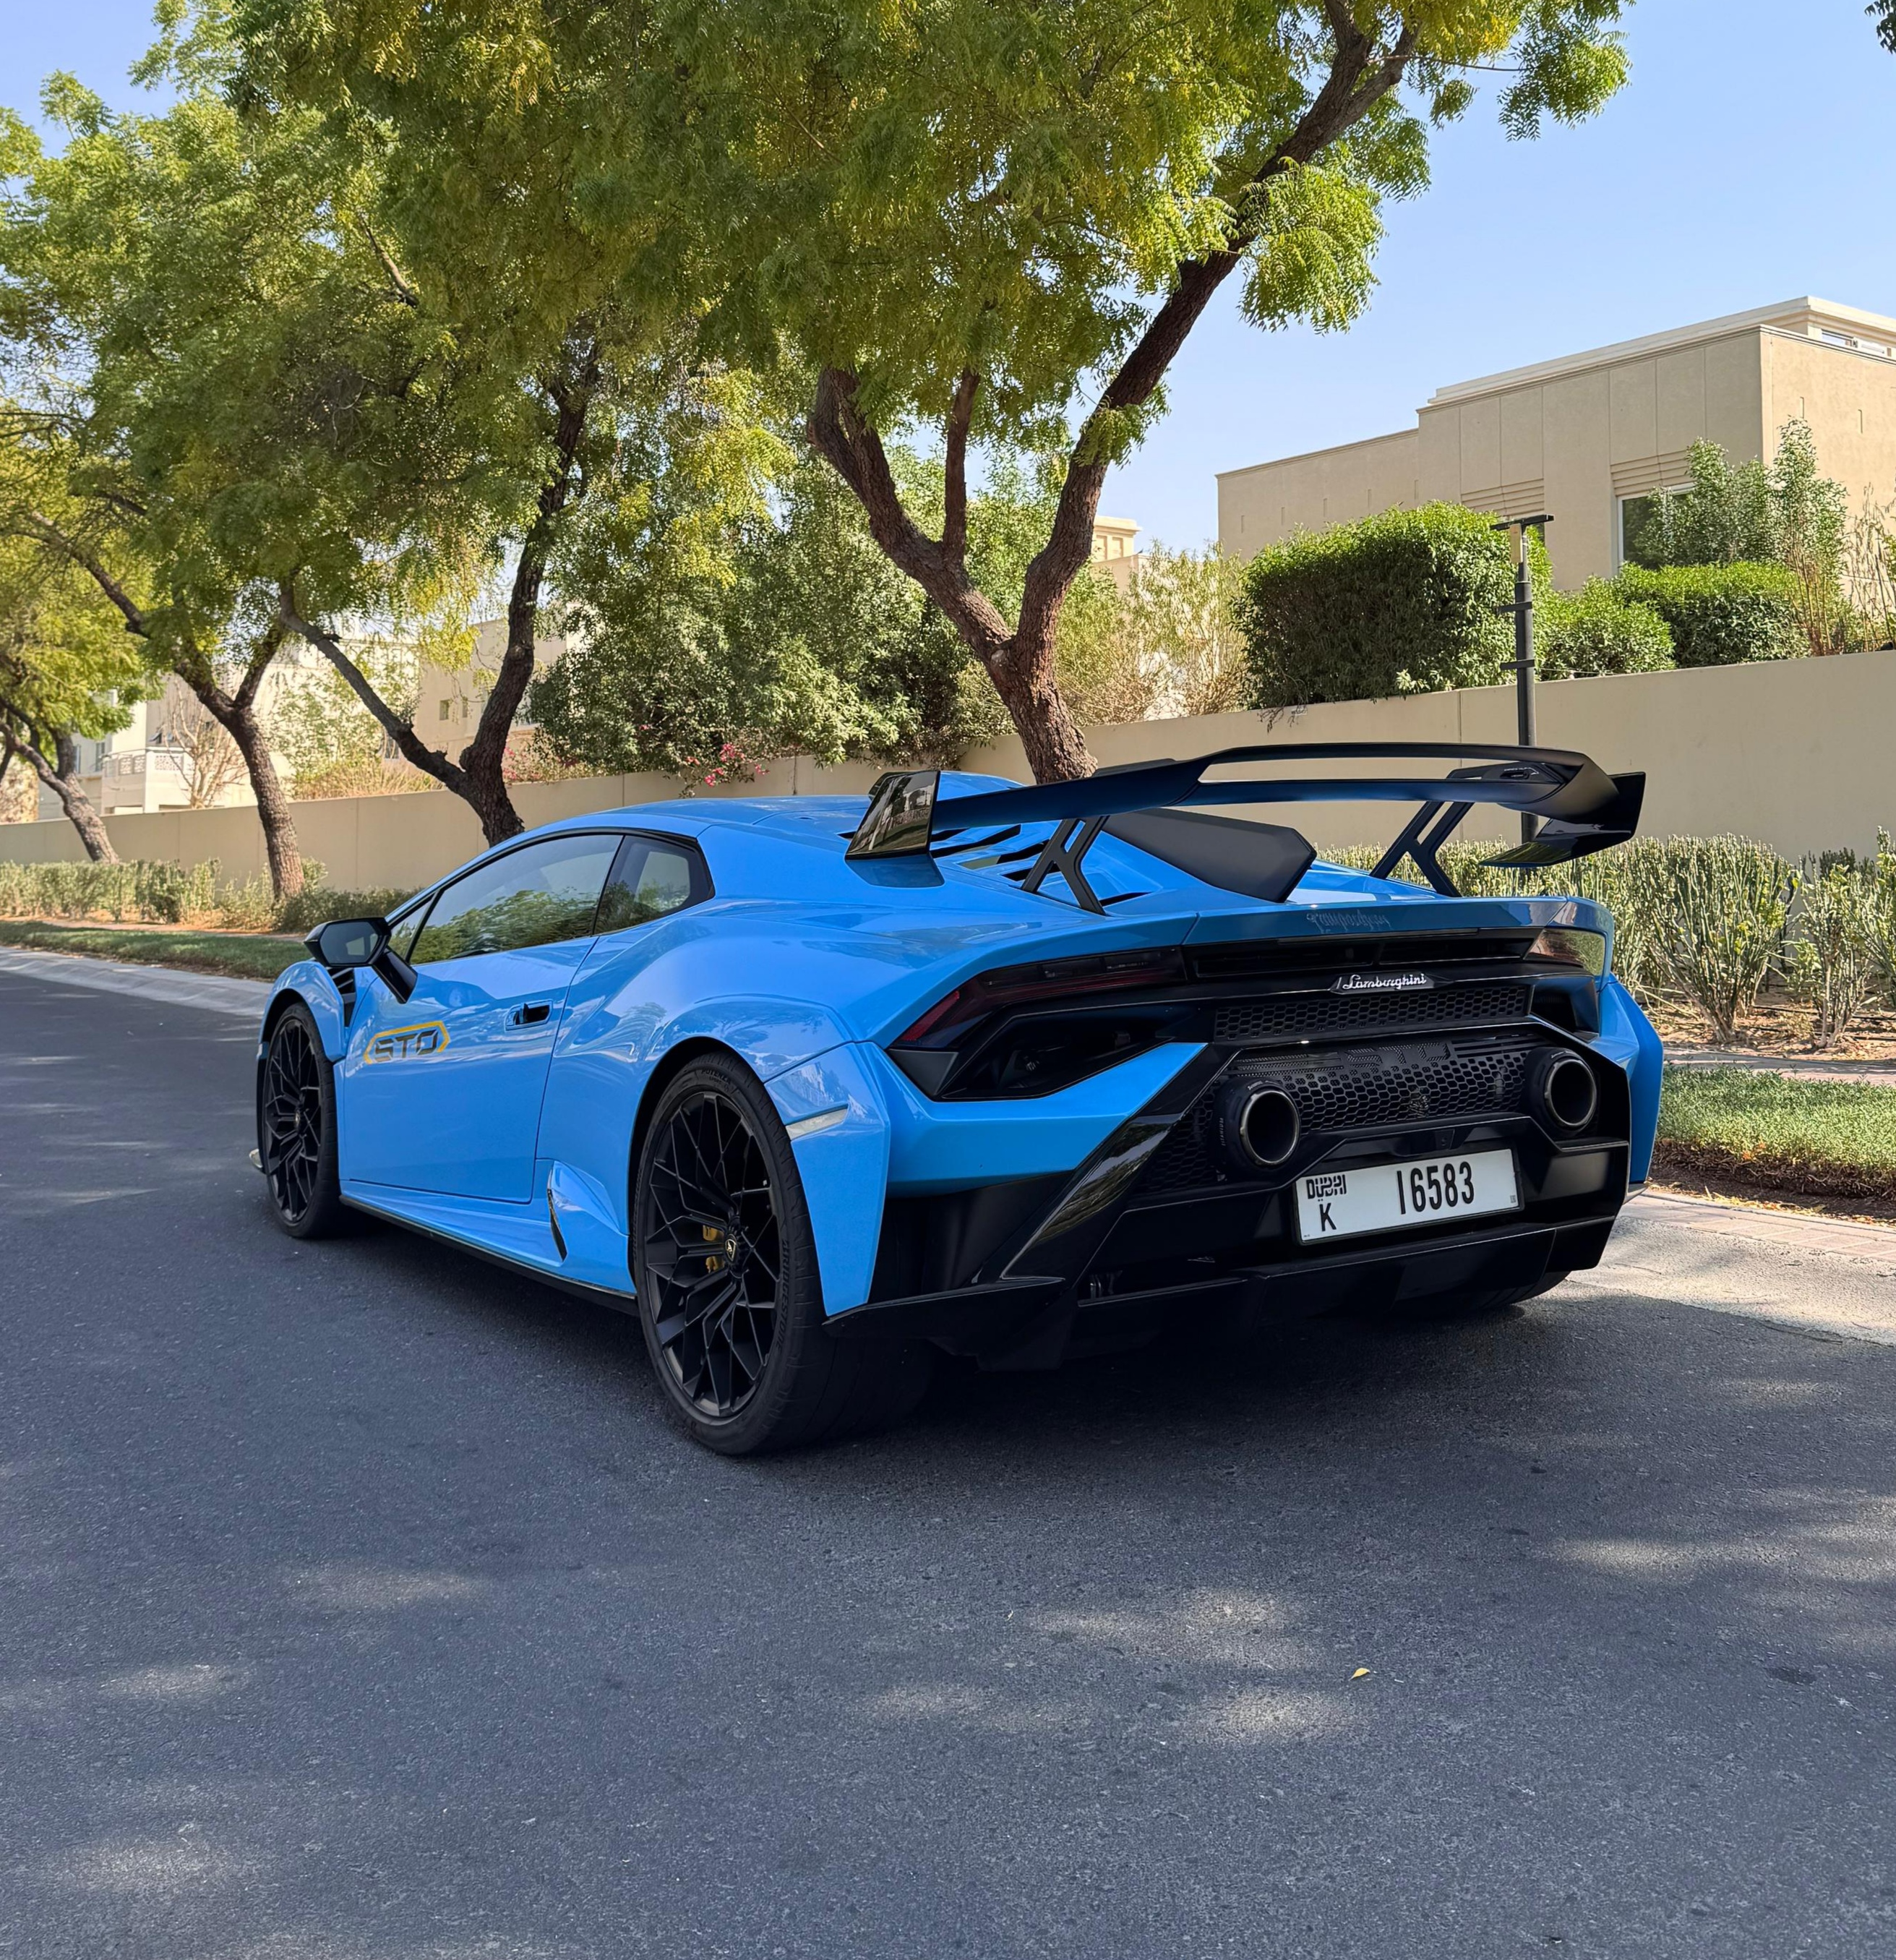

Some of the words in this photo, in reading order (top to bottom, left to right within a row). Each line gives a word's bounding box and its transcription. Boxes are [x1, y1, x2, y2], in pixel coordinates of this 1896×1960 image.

[1342, 973, 1427, 990] Lamborghini
[375, 1029, 438, 1063] STO
[1344, 1042, 1451, 1069] STO
[1397, 1162, 1475, 1215] 16583
[1319, 1202, 1337, 1232] K
